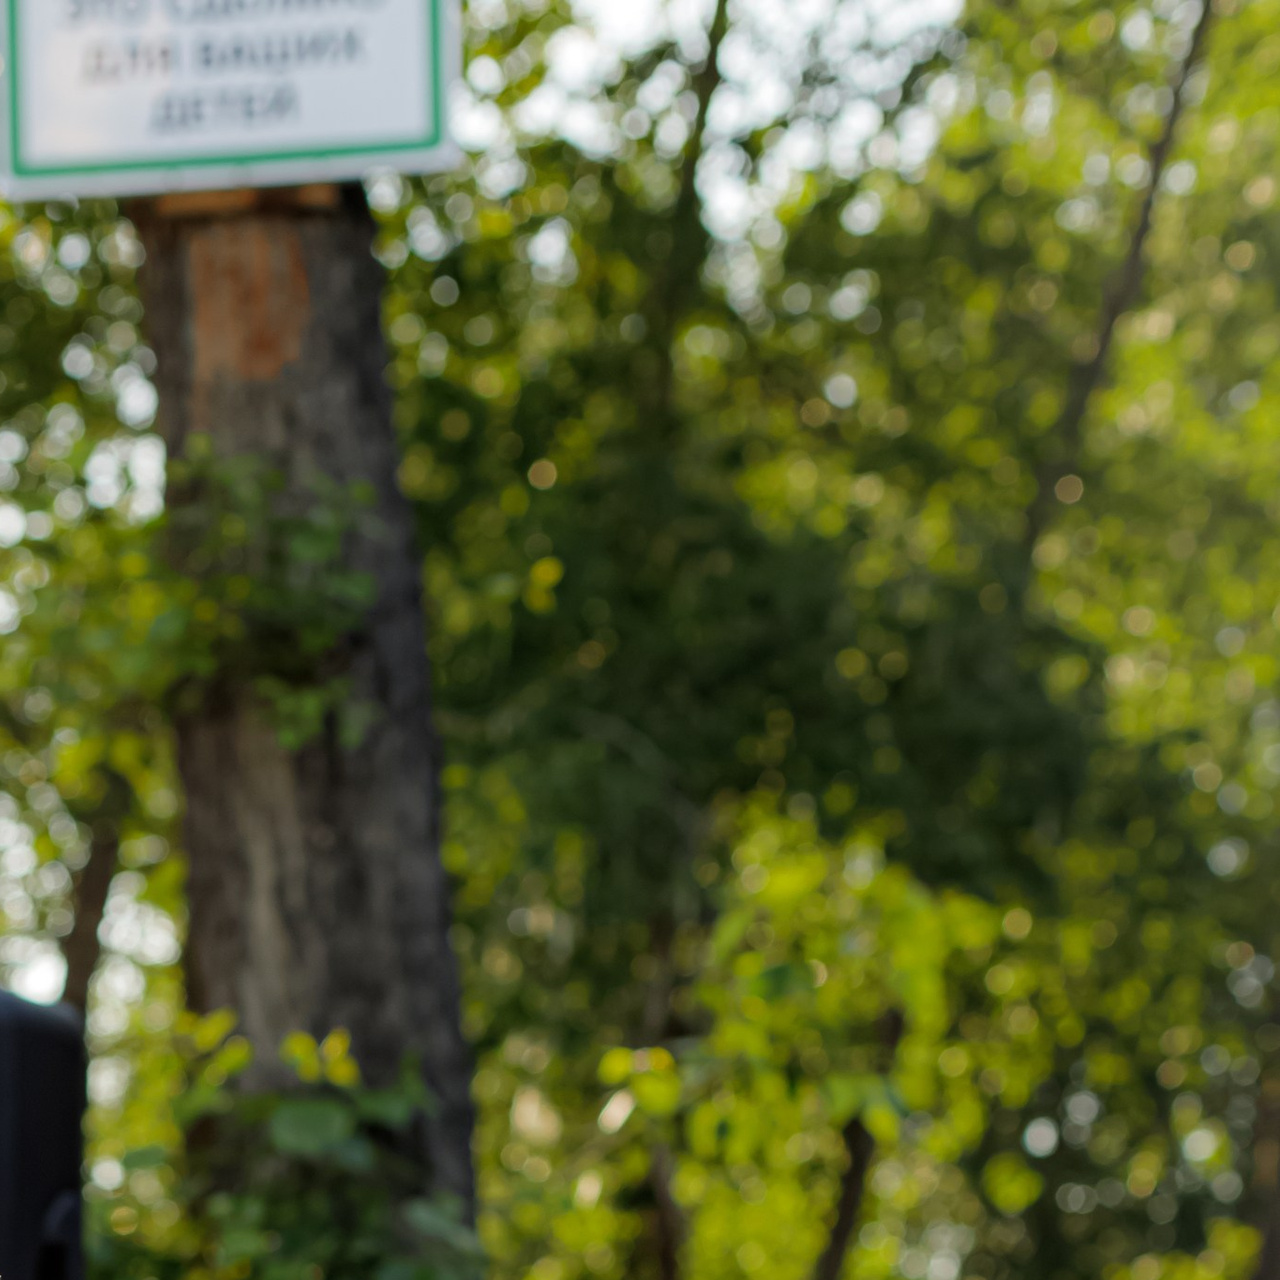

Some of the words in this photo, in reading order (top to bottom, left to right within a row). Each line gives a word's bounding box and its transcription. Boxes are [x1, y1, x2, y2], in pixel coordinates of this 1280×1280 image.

[82, 40, 172, 83] ДЛЯ
[200, 31, 362, 69] ВАШИХ
[151, 84, 298, 131] ДЕТЕЙ
